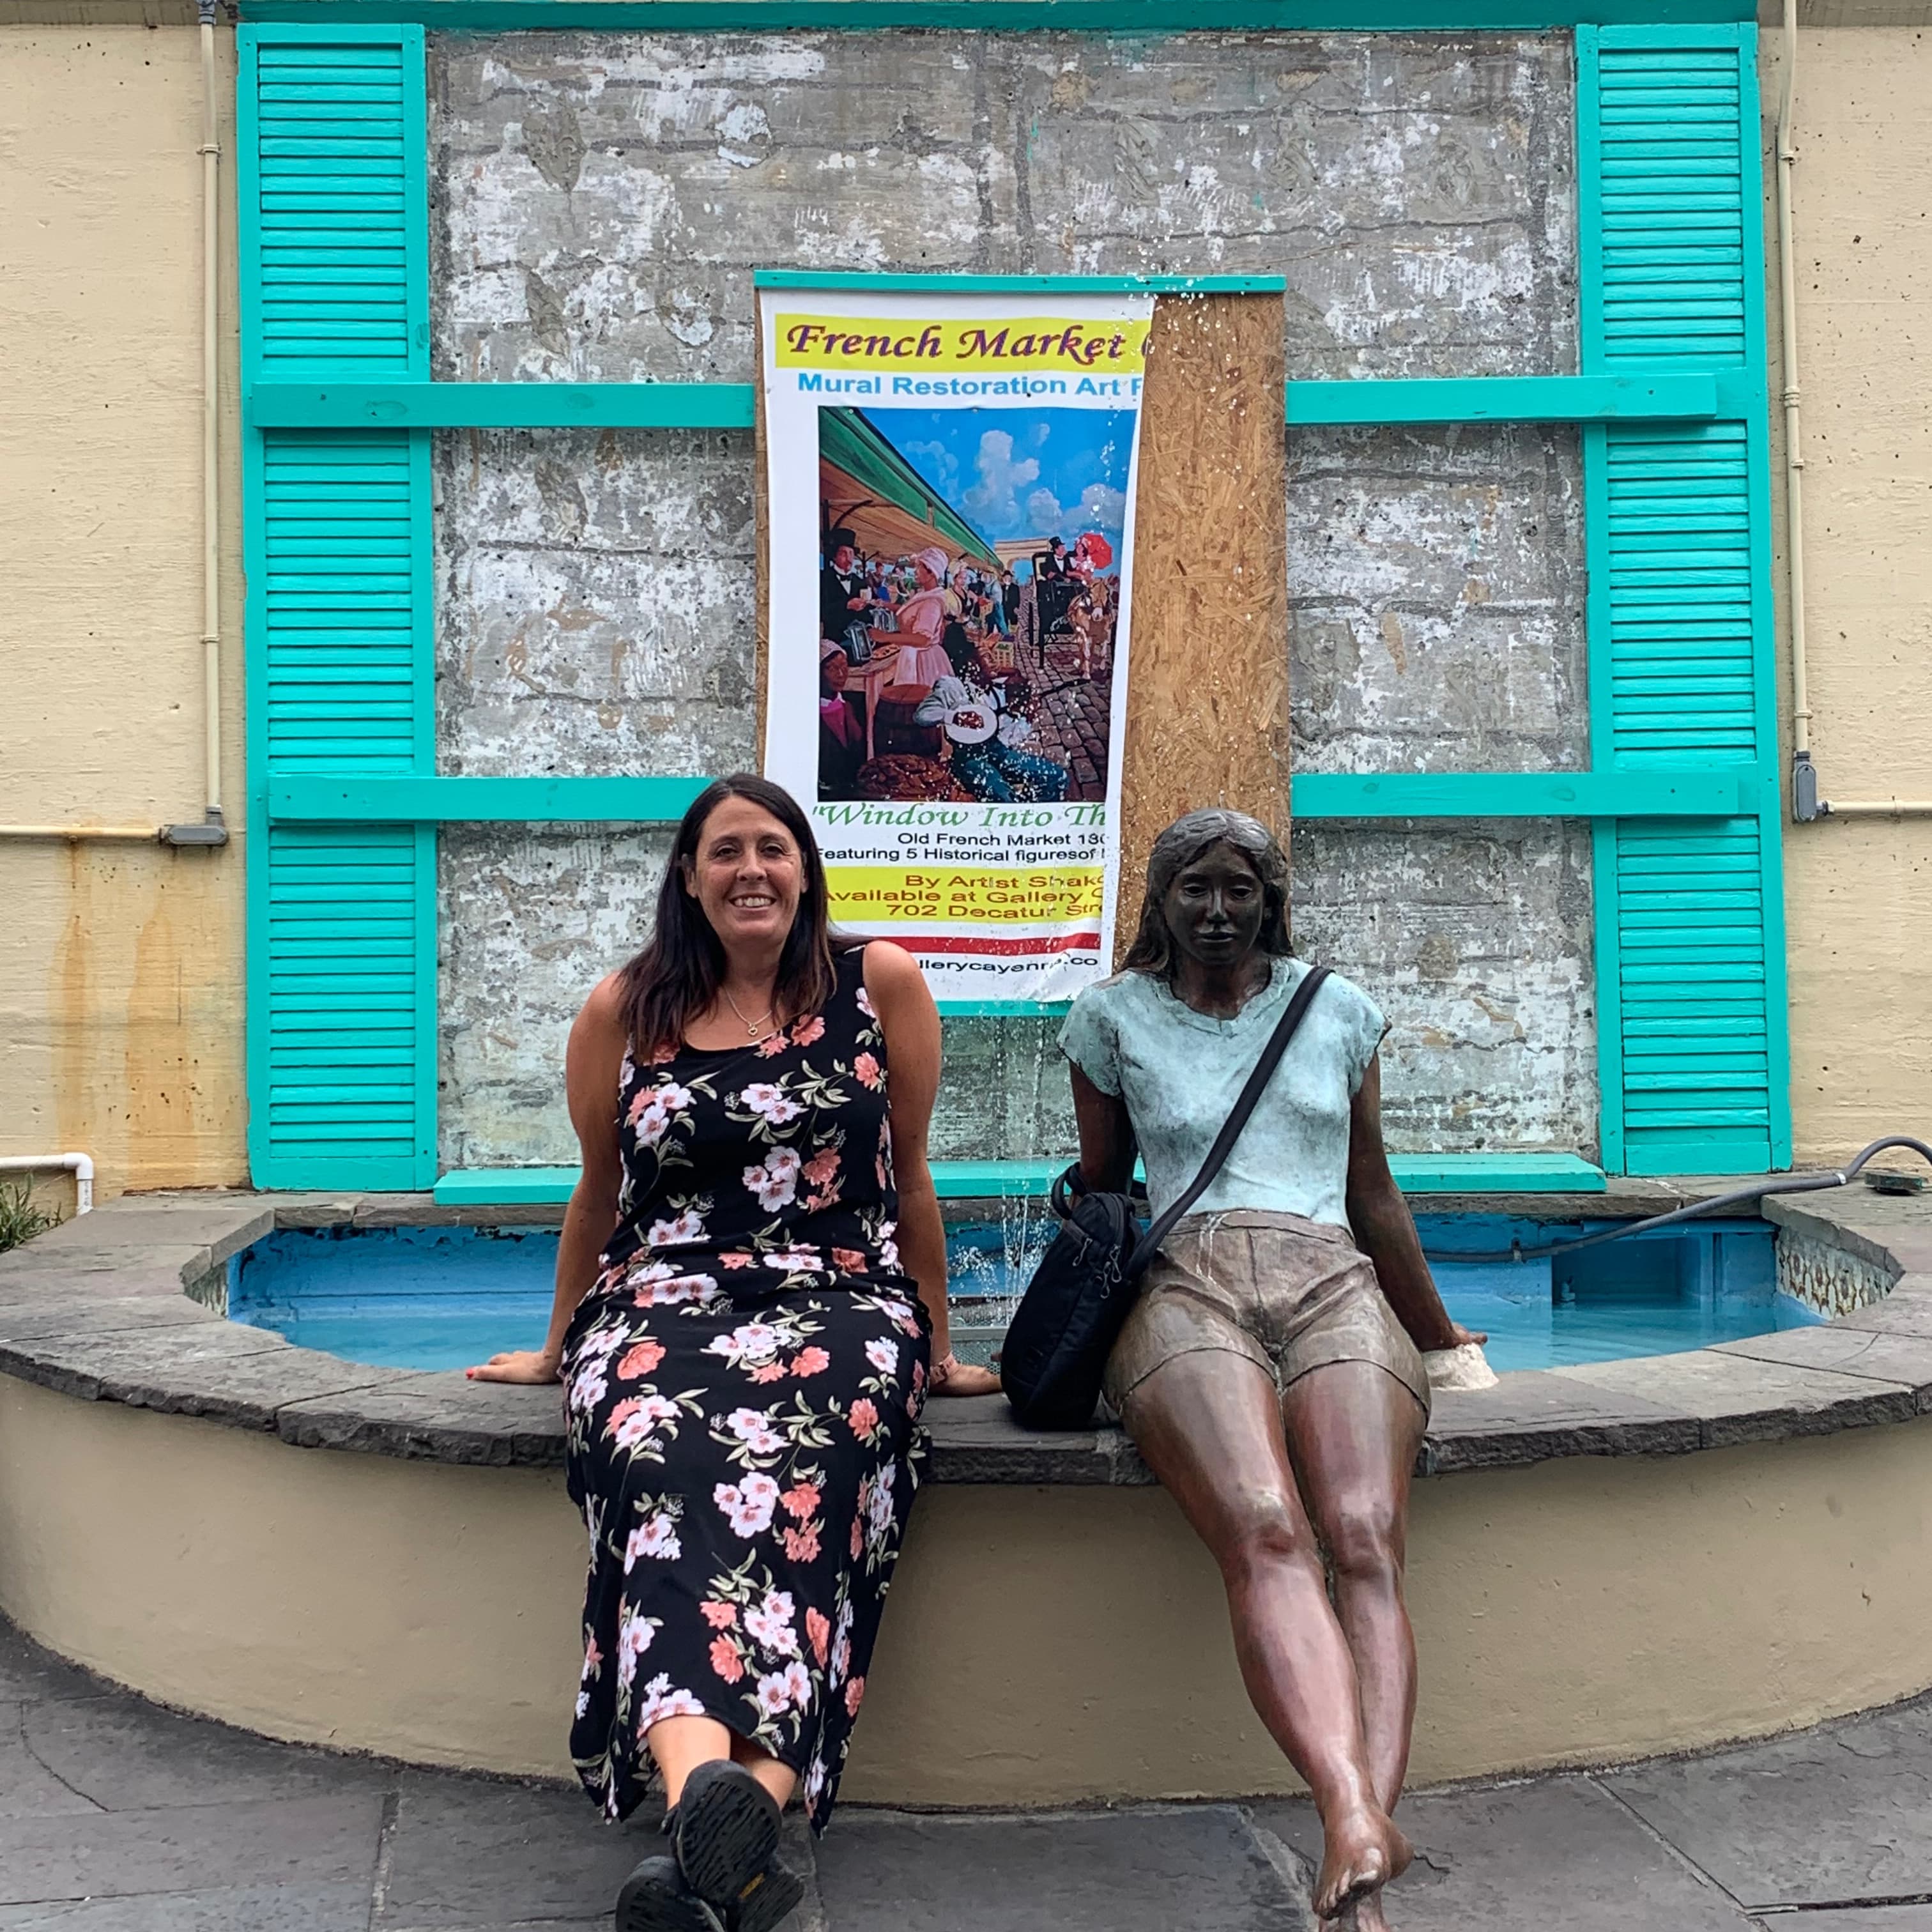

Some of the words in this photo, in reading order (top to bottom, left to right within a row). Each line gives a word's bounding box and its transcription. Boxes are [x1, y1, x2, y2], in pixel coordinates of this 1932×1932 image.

[786, 325, 943, 358] French
[956, 325, 1126, 365] Market
[798, 373, 881, 394] Mural
[893, 376, 1066, 395] Restoration
[1075, 378, 1121, 395] Art
[979, 807, 1053, 827] Into
[898, 832, 929, 845] Old
[937, 833, 1000, 846] French
[1008, 834, 1071, 846] Market
[906, 848, 917, 859] 5
[924, 848, 1009, 861] Historical
[905, 875, 940, 889] By
[947, 876, 1019, 889] Artist
[951, 891, 977, 902] at
[986, 891, 1084, 904] Gallery
[886, 905, 937, 916] 702
[949, 905, 1057, 919] Decatur
